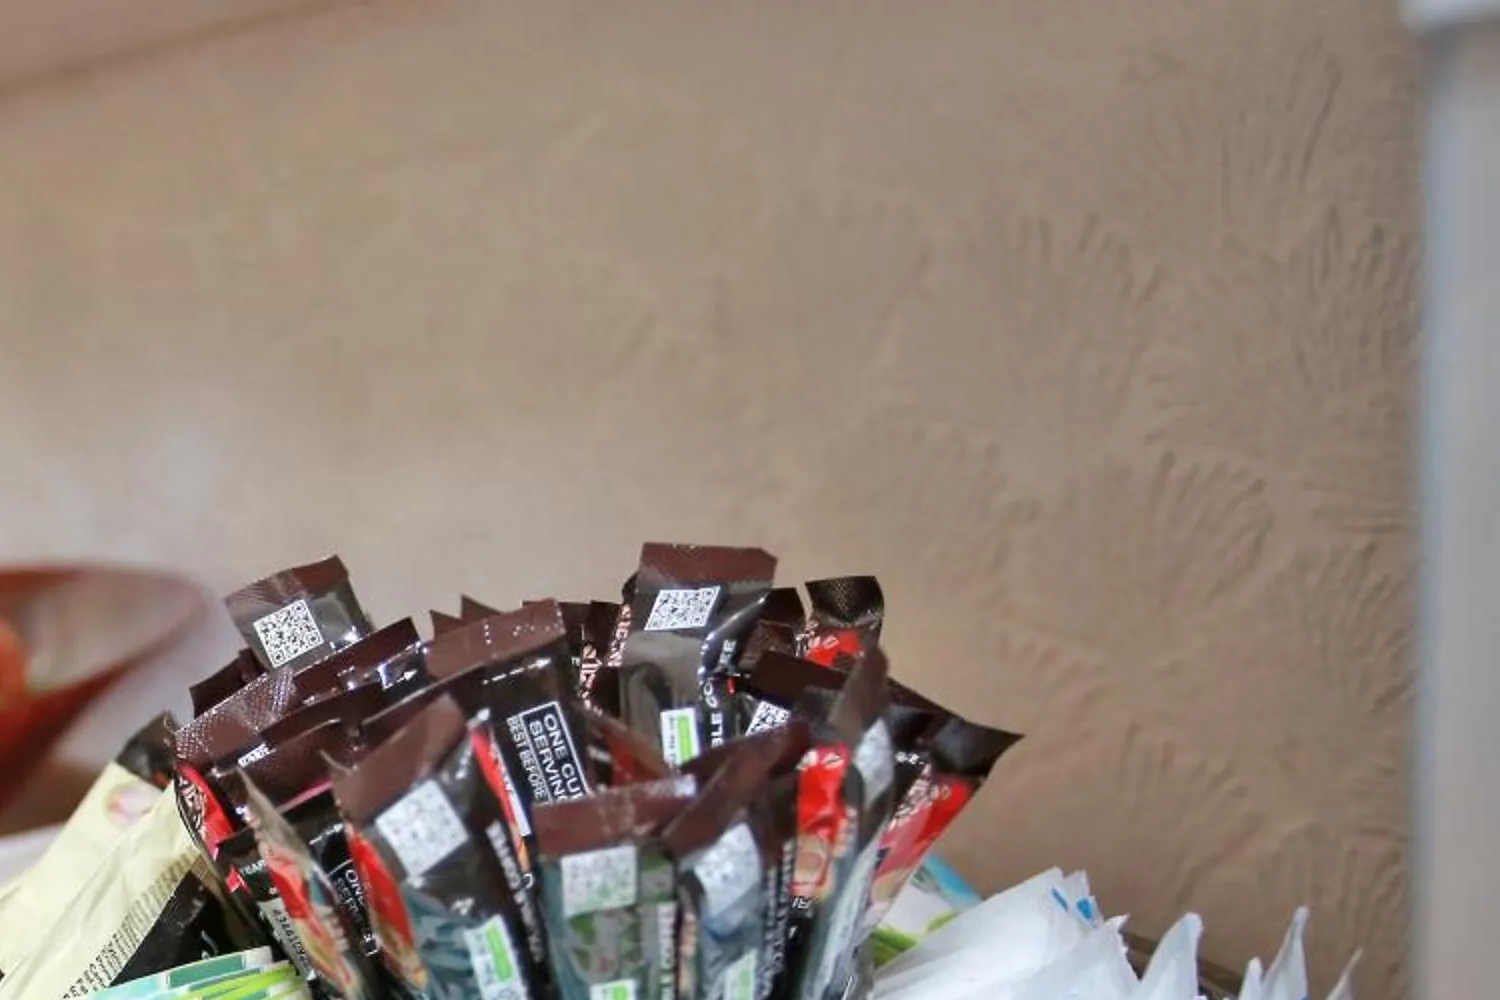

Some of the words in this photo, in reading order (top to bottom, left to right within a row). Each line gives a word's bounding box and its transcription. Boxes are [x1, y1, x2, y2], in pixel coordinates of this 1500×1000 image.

[506, 713, 529, 749] BEST
[519, 749, 549, 800] BEFORE
[543, 712, 569, 759] ONE
